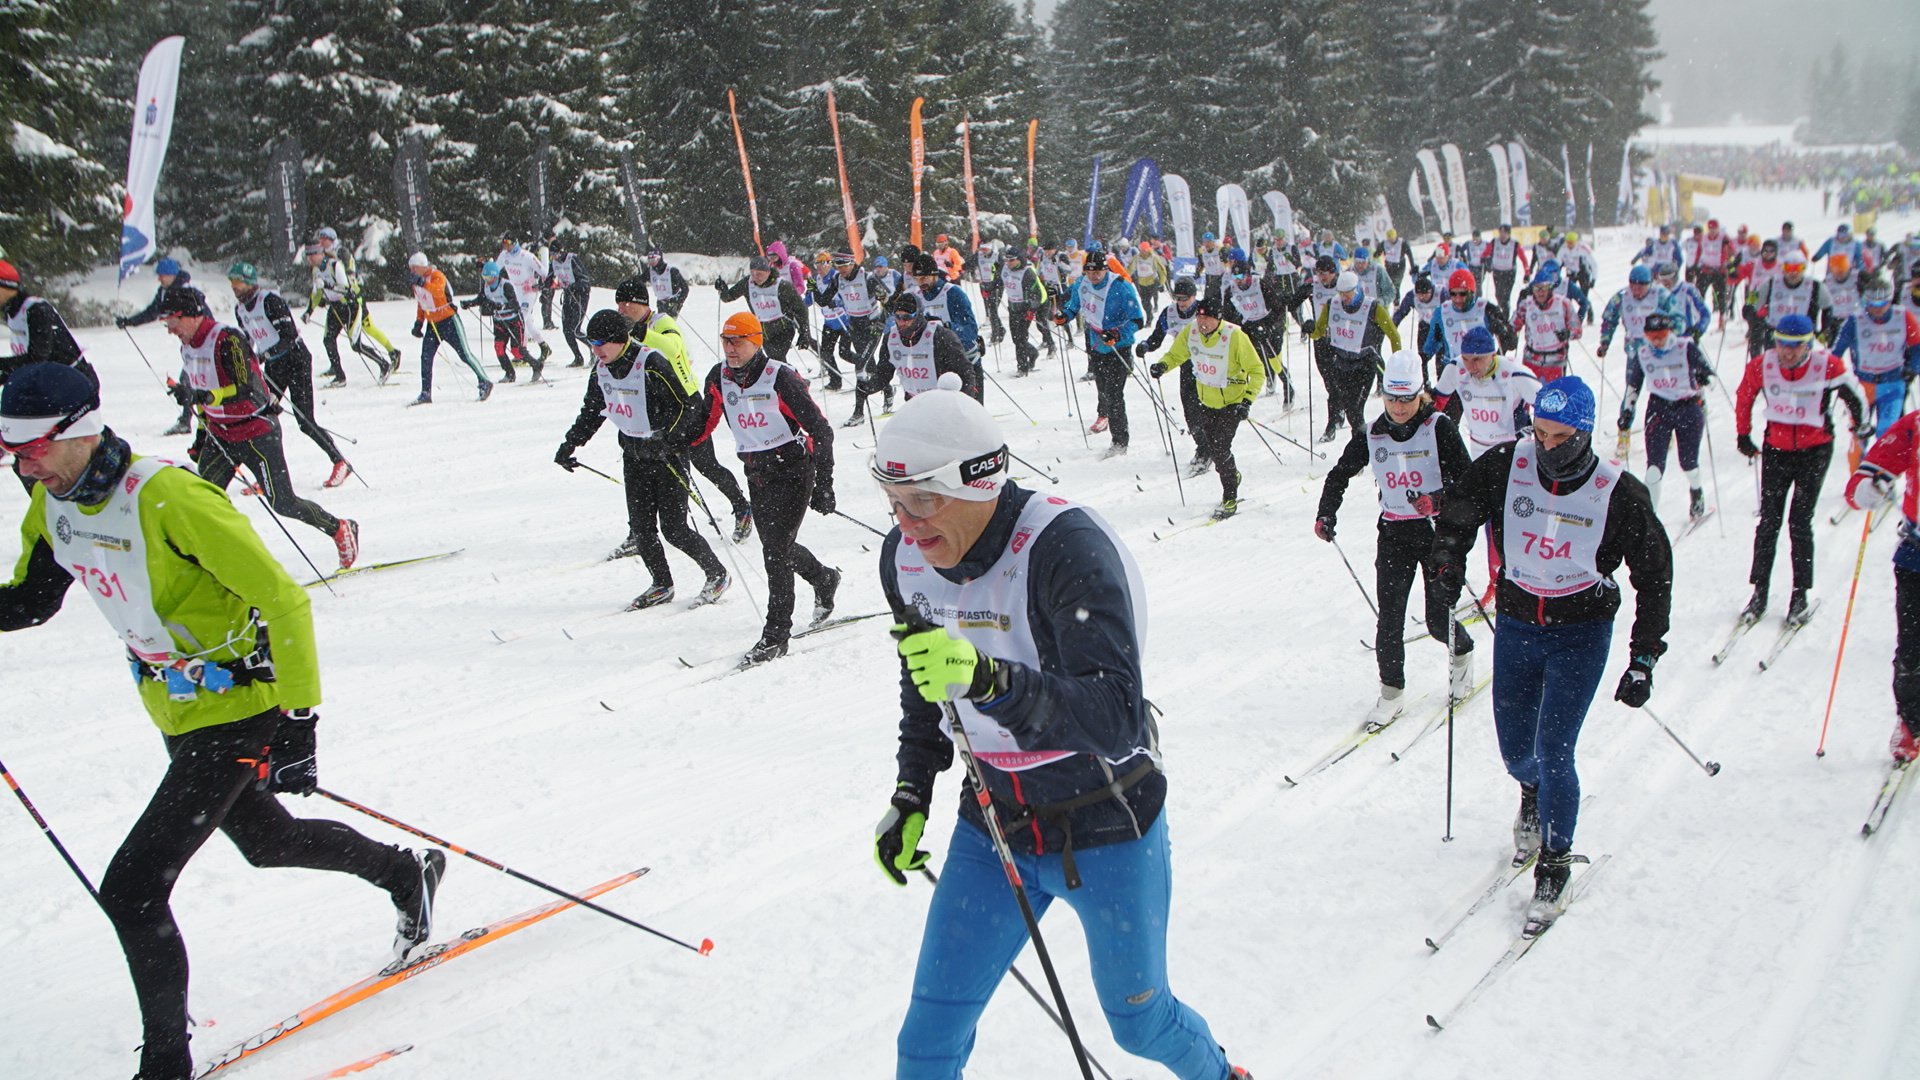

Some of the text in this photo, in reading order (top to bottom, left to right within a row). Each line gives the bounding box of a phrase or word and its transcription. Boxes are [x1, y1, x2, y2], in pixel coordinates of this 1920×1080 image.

[898, 366, 929, 379] 1062
[608, 402, 633, 418] 740
[1471, 408, 1499, 423] 500
[738, 412, 769, 429] 642
[1386, 471, 1423, 489] 849
[1522, 531, 1572, 560] 754
[72, 563, 128, 602] 731
[1565, 570, 1589, 580] KGHM
